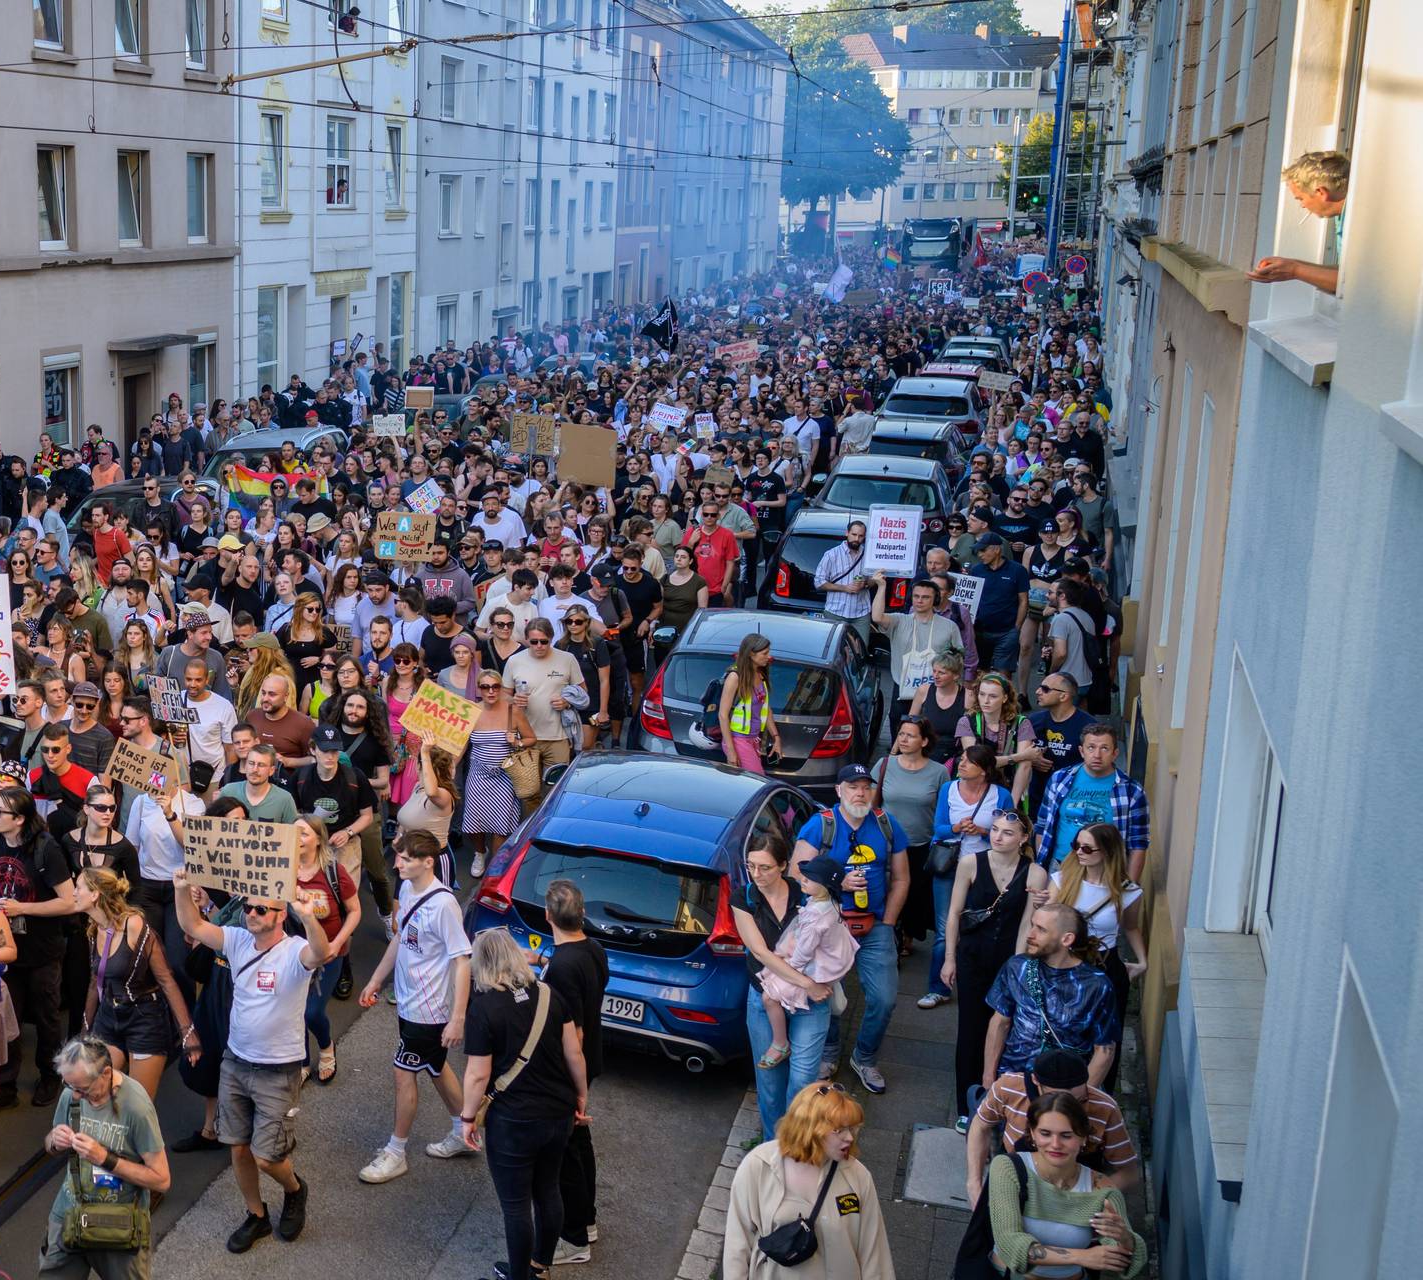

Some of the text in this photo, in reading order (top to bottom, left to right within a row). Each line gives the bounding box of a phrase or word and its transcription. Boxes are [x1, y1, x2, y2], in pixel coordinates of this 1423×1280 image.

[398, 517, 409, 532] A
[880, 517, 907, 529] Nazis
[878, 529, 907, 540] töten.
[876, 542, 907, 552] Nazipartei
[956, 577, 977, 590] JÖRN
[954, 588, 975, 600] ÖCKE
[421, 683, 473, 720] HASS
[414, 696, 470, 732] MACHT
[114, 755, 143, 775] keine
[117, 742, 167, 773] Hass ist
[220, 820, 239, 833] DIE
[247, 823, 275, 841] AfD
[189, 835, 282, 852] DIE ANTWORT
[206, 849, 232, 864] WIE
[243, 854, 290, 869] DUMM
[211, 866, 240, 879] DANN
[246, 870, 269, 881] DIE
[222, 879, 270, 897] FRAGE
[605, 997, 642, 1018] 1996
